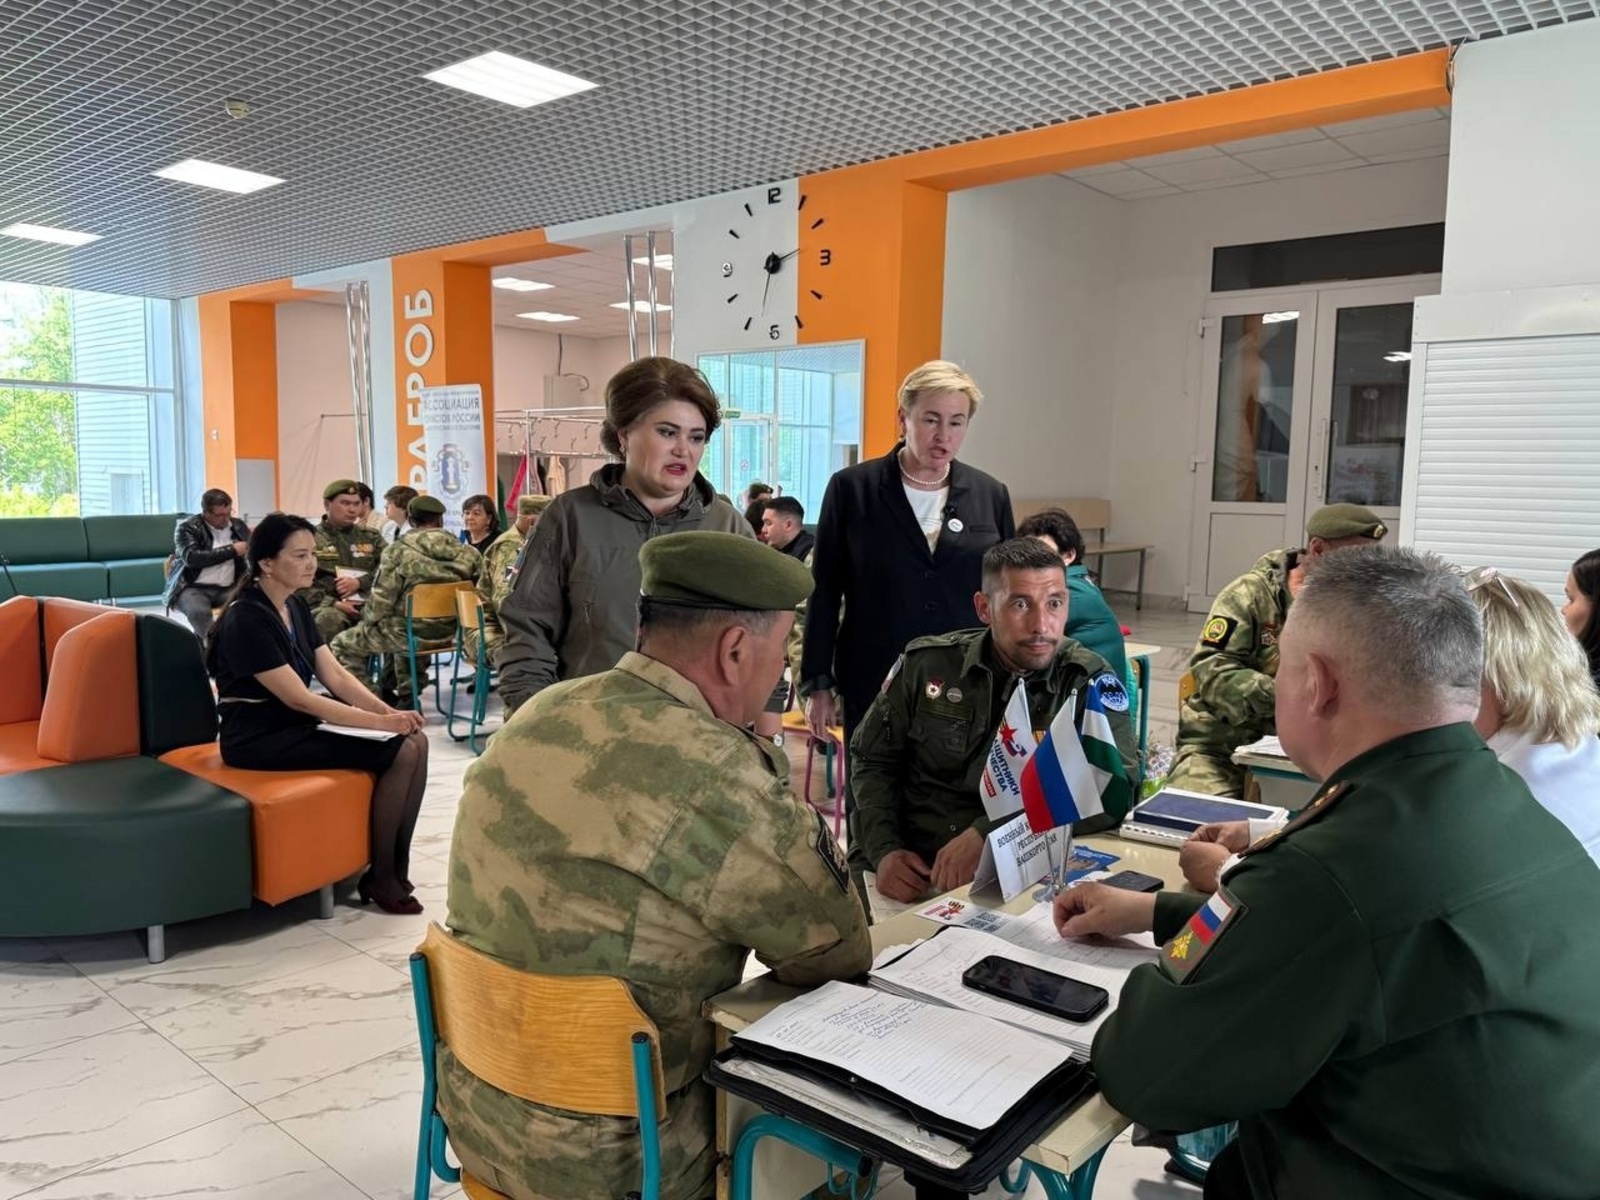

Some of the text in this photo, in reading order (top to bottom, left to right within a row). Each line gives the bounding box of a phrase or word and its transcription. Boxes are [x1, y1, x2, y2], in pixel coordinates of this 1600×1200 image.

[768, 187, 781, 205] 12
[820, 249, 831, 266] 3
[721, 262, 733, 278] 9
